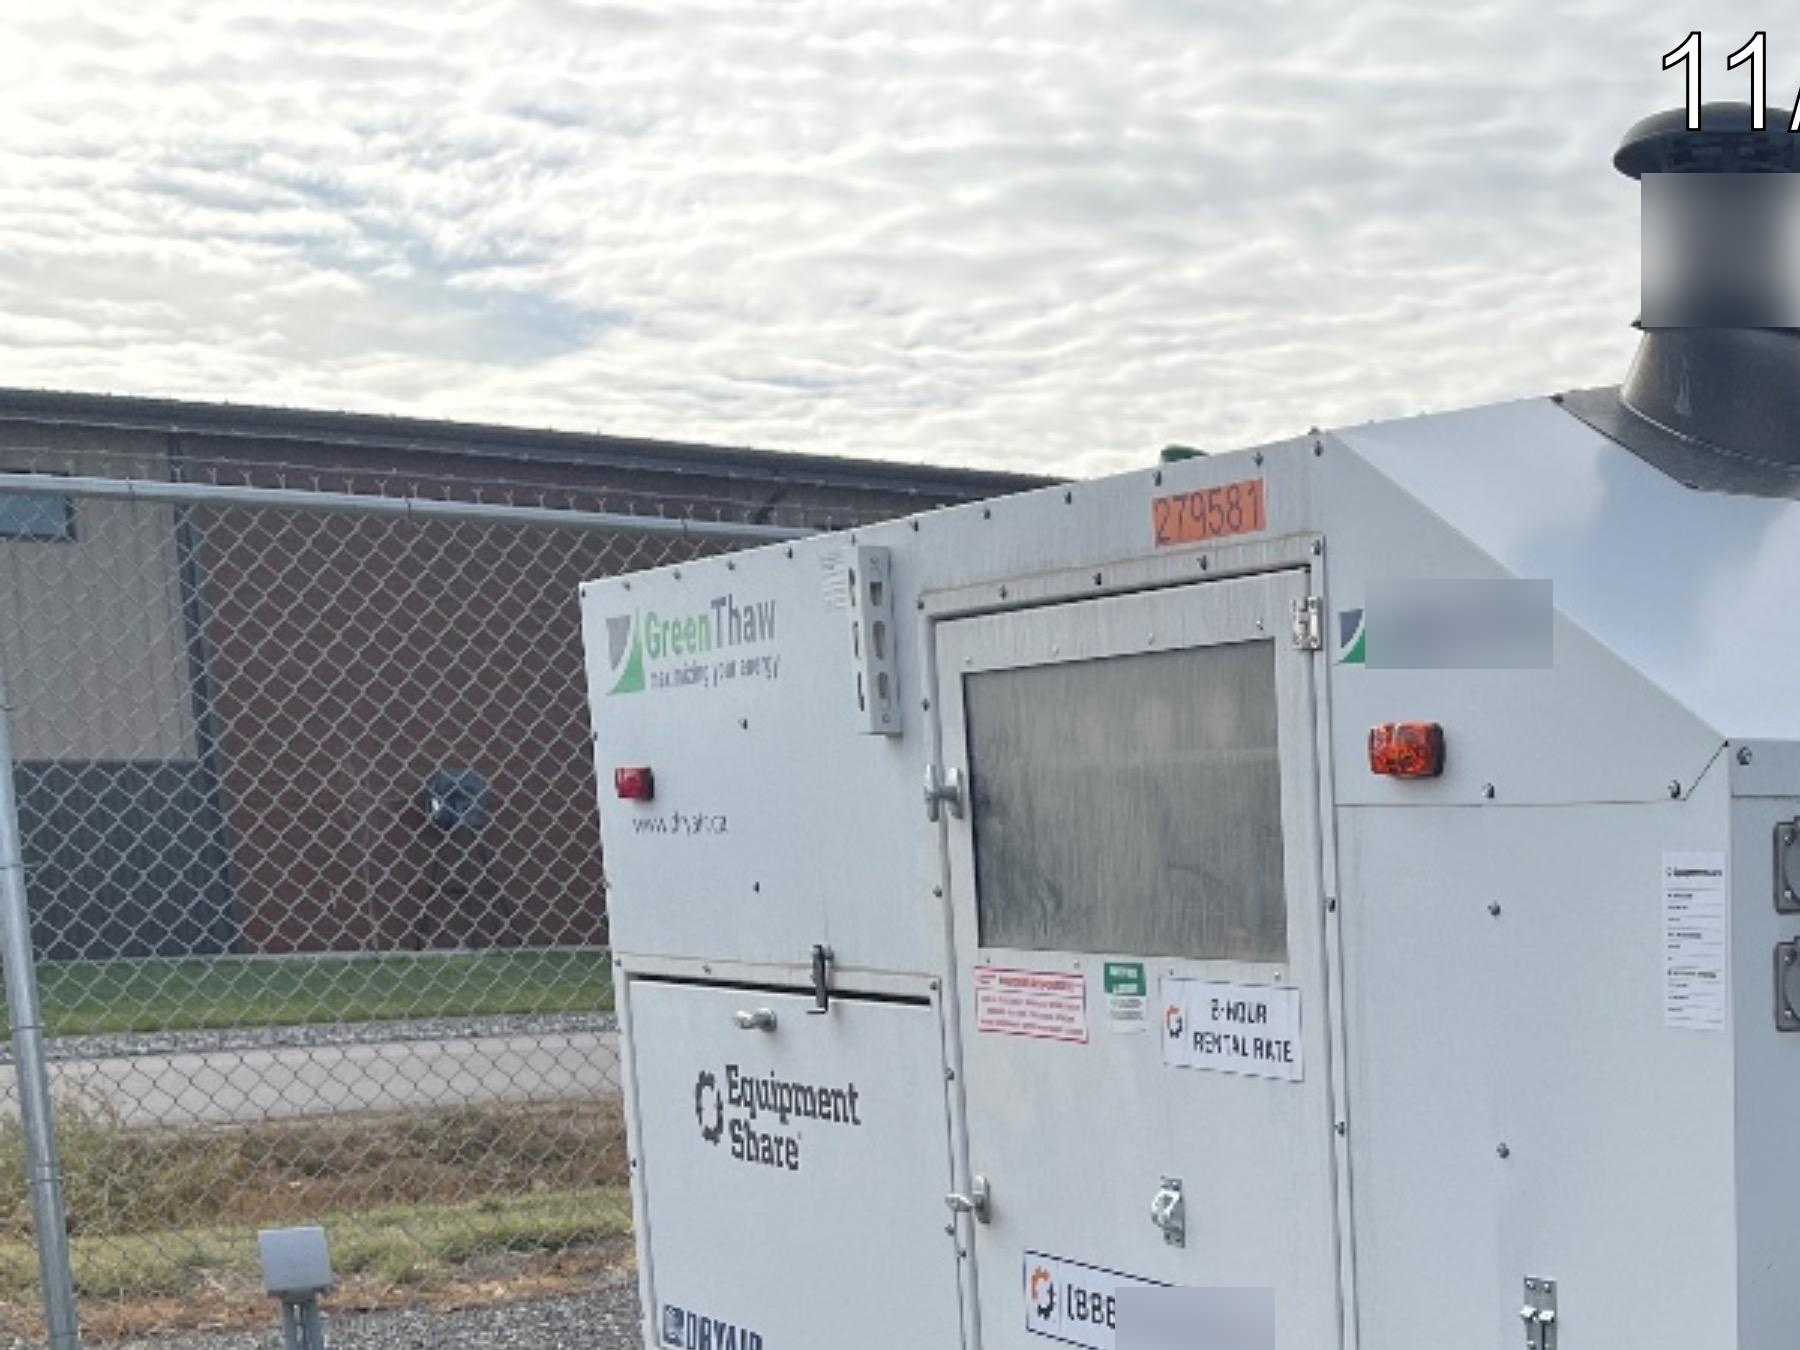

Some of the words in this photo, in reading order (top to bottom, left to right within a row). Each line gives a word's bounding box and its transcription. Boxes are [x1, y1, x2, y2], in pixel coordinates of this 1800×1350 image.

[1154, 482, 1257, 543] 279581
[645, 594, 776, 658] GreenThaw
[1253, 1037, 1294, 1063] RATE
[725, 1064, 861, 1126] Equipment
[729, 1118, 800, 1171] Share
